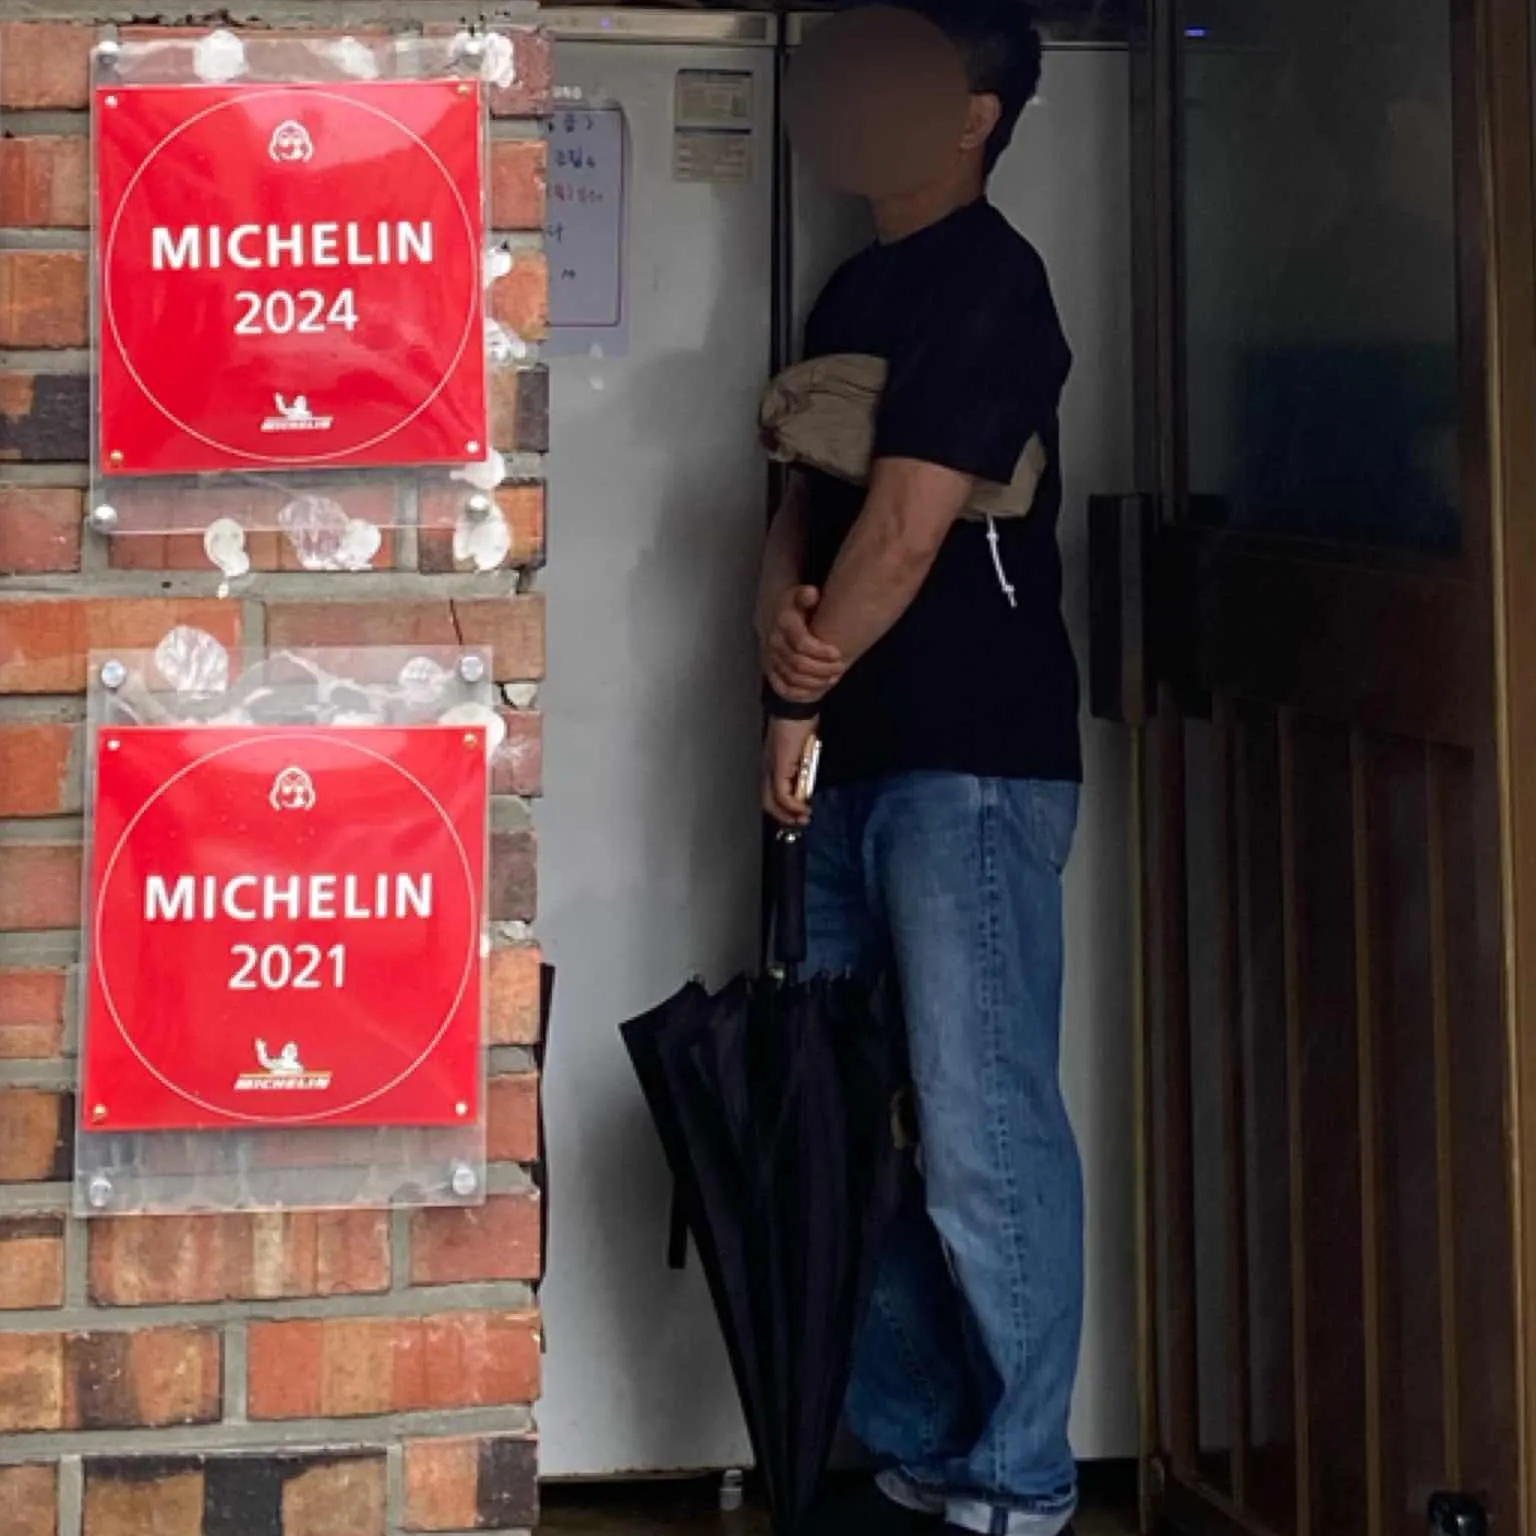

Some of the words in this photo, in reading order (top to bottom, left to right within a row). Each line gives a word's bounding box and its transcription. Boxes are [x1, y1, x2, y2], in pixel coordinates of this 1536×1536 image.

[151, 221, 433, 270] MICHELIN
[234, 288, 358, 334] 2024
[144, 872, 433, 921] MICHELIN
[229, 944, 346, 990] 2021
